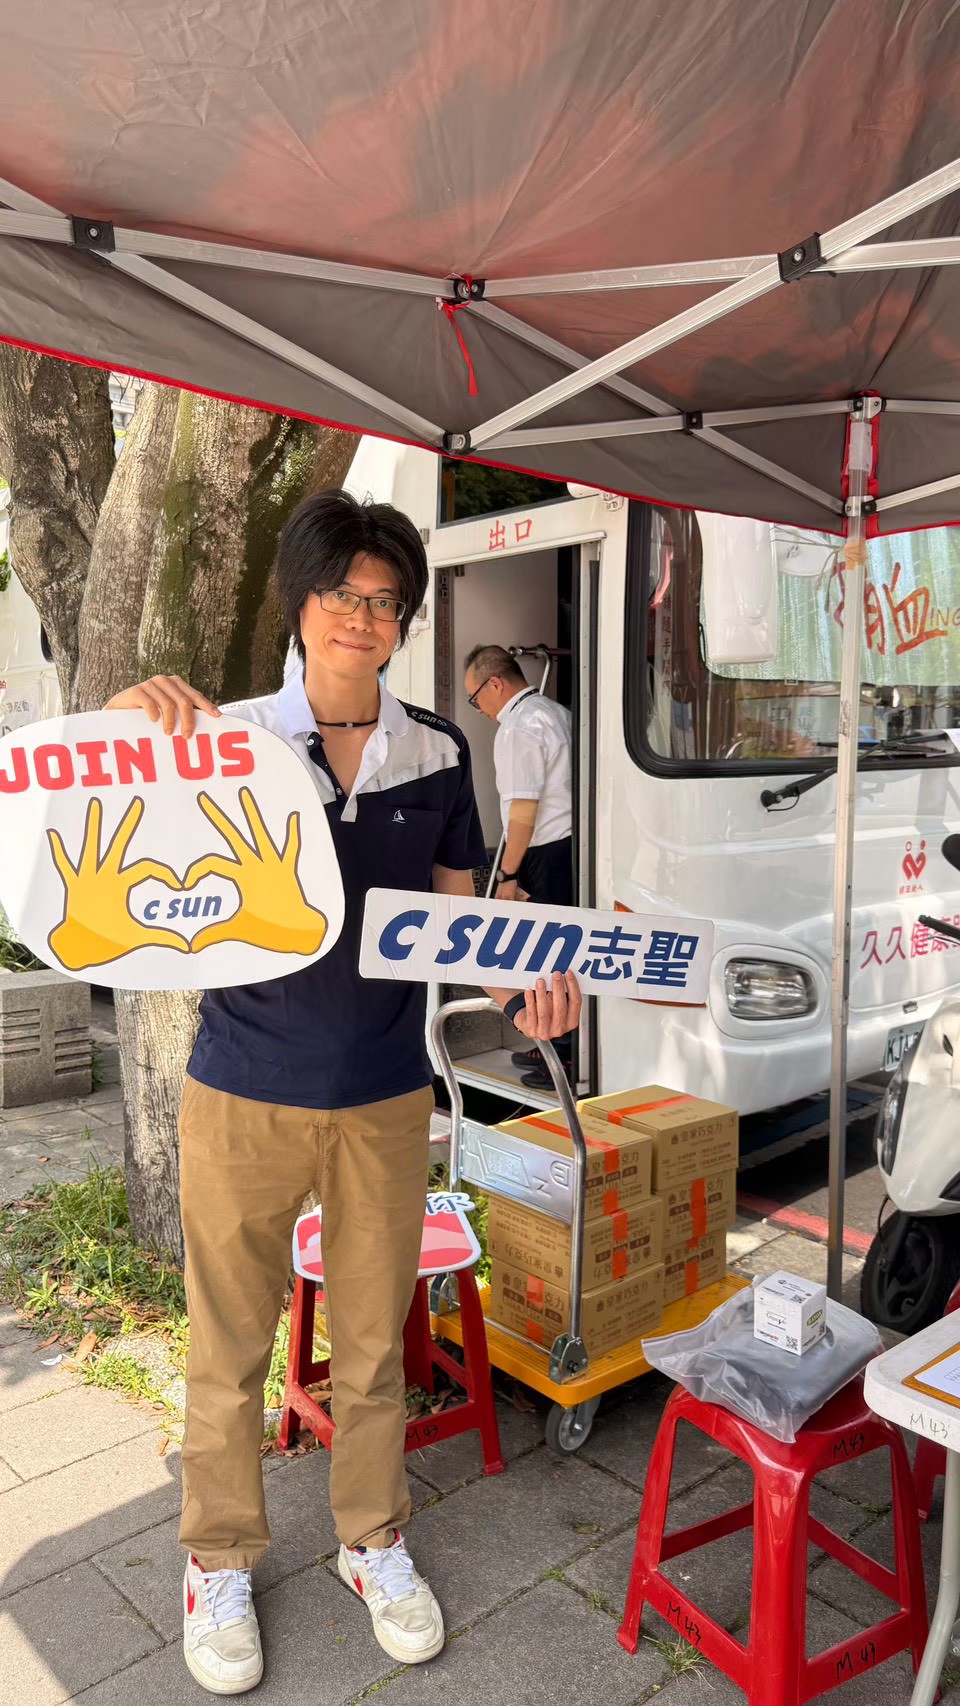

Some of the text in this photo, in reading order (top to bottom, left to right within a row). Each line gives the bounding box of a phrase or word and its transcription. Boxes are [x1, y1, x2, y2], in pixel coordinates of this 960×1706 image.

[489, 519, 533, 551] 出口
[418, 713, 437, 723] sun
[0, 731, 255, 793] JOIN US
[166, 895, 222, 919] sun
[434, 914, 584, 973] sun
[578, 925, 699, 988] 志聖
